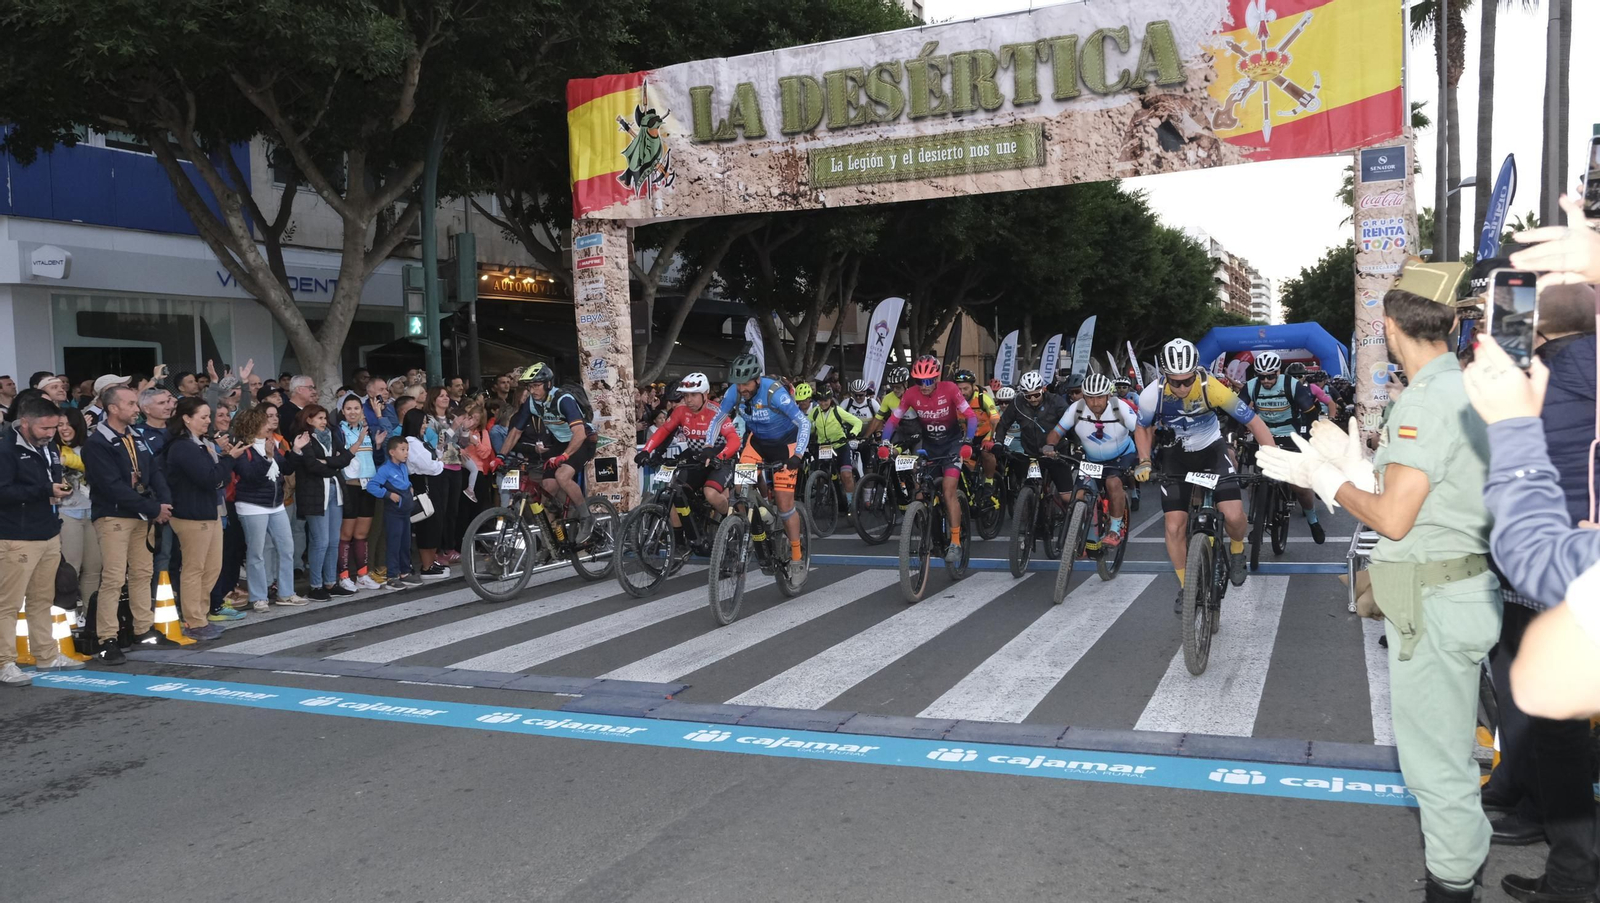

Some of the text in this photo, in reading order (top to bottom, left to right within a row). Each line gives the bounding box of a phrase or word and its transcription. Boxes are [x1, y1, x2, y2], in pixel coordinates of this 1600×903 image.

[689, 20, 1189, 143] LA DESÉRTICA
[830, 141, 1017, 172] La Legión y el desierto nos une
[1362, 218, 1404, 227] GRUPO
[1362, 226, 1405, 238] RENTA
[1362, 237, 1405, 251] TODO
[32, 259, 64, 267] VITALDENT
[580, 313, 604, 324] BBVA
[1081, 462, 1102, 473] 10093
[1192, 471, 1217, 482] 10240
[40, 673, 130, 686] cajamar
[182, 685, 280, 700] cajamar
[336, 701, 449, 717] cajamar
[522, 717, 649, 735] cajamar
[736, 736, 881, 753] cajamar
[987, 755, 1157, 774] cajamar
[1064, 768, 1147, 779] CAJA RURAL
